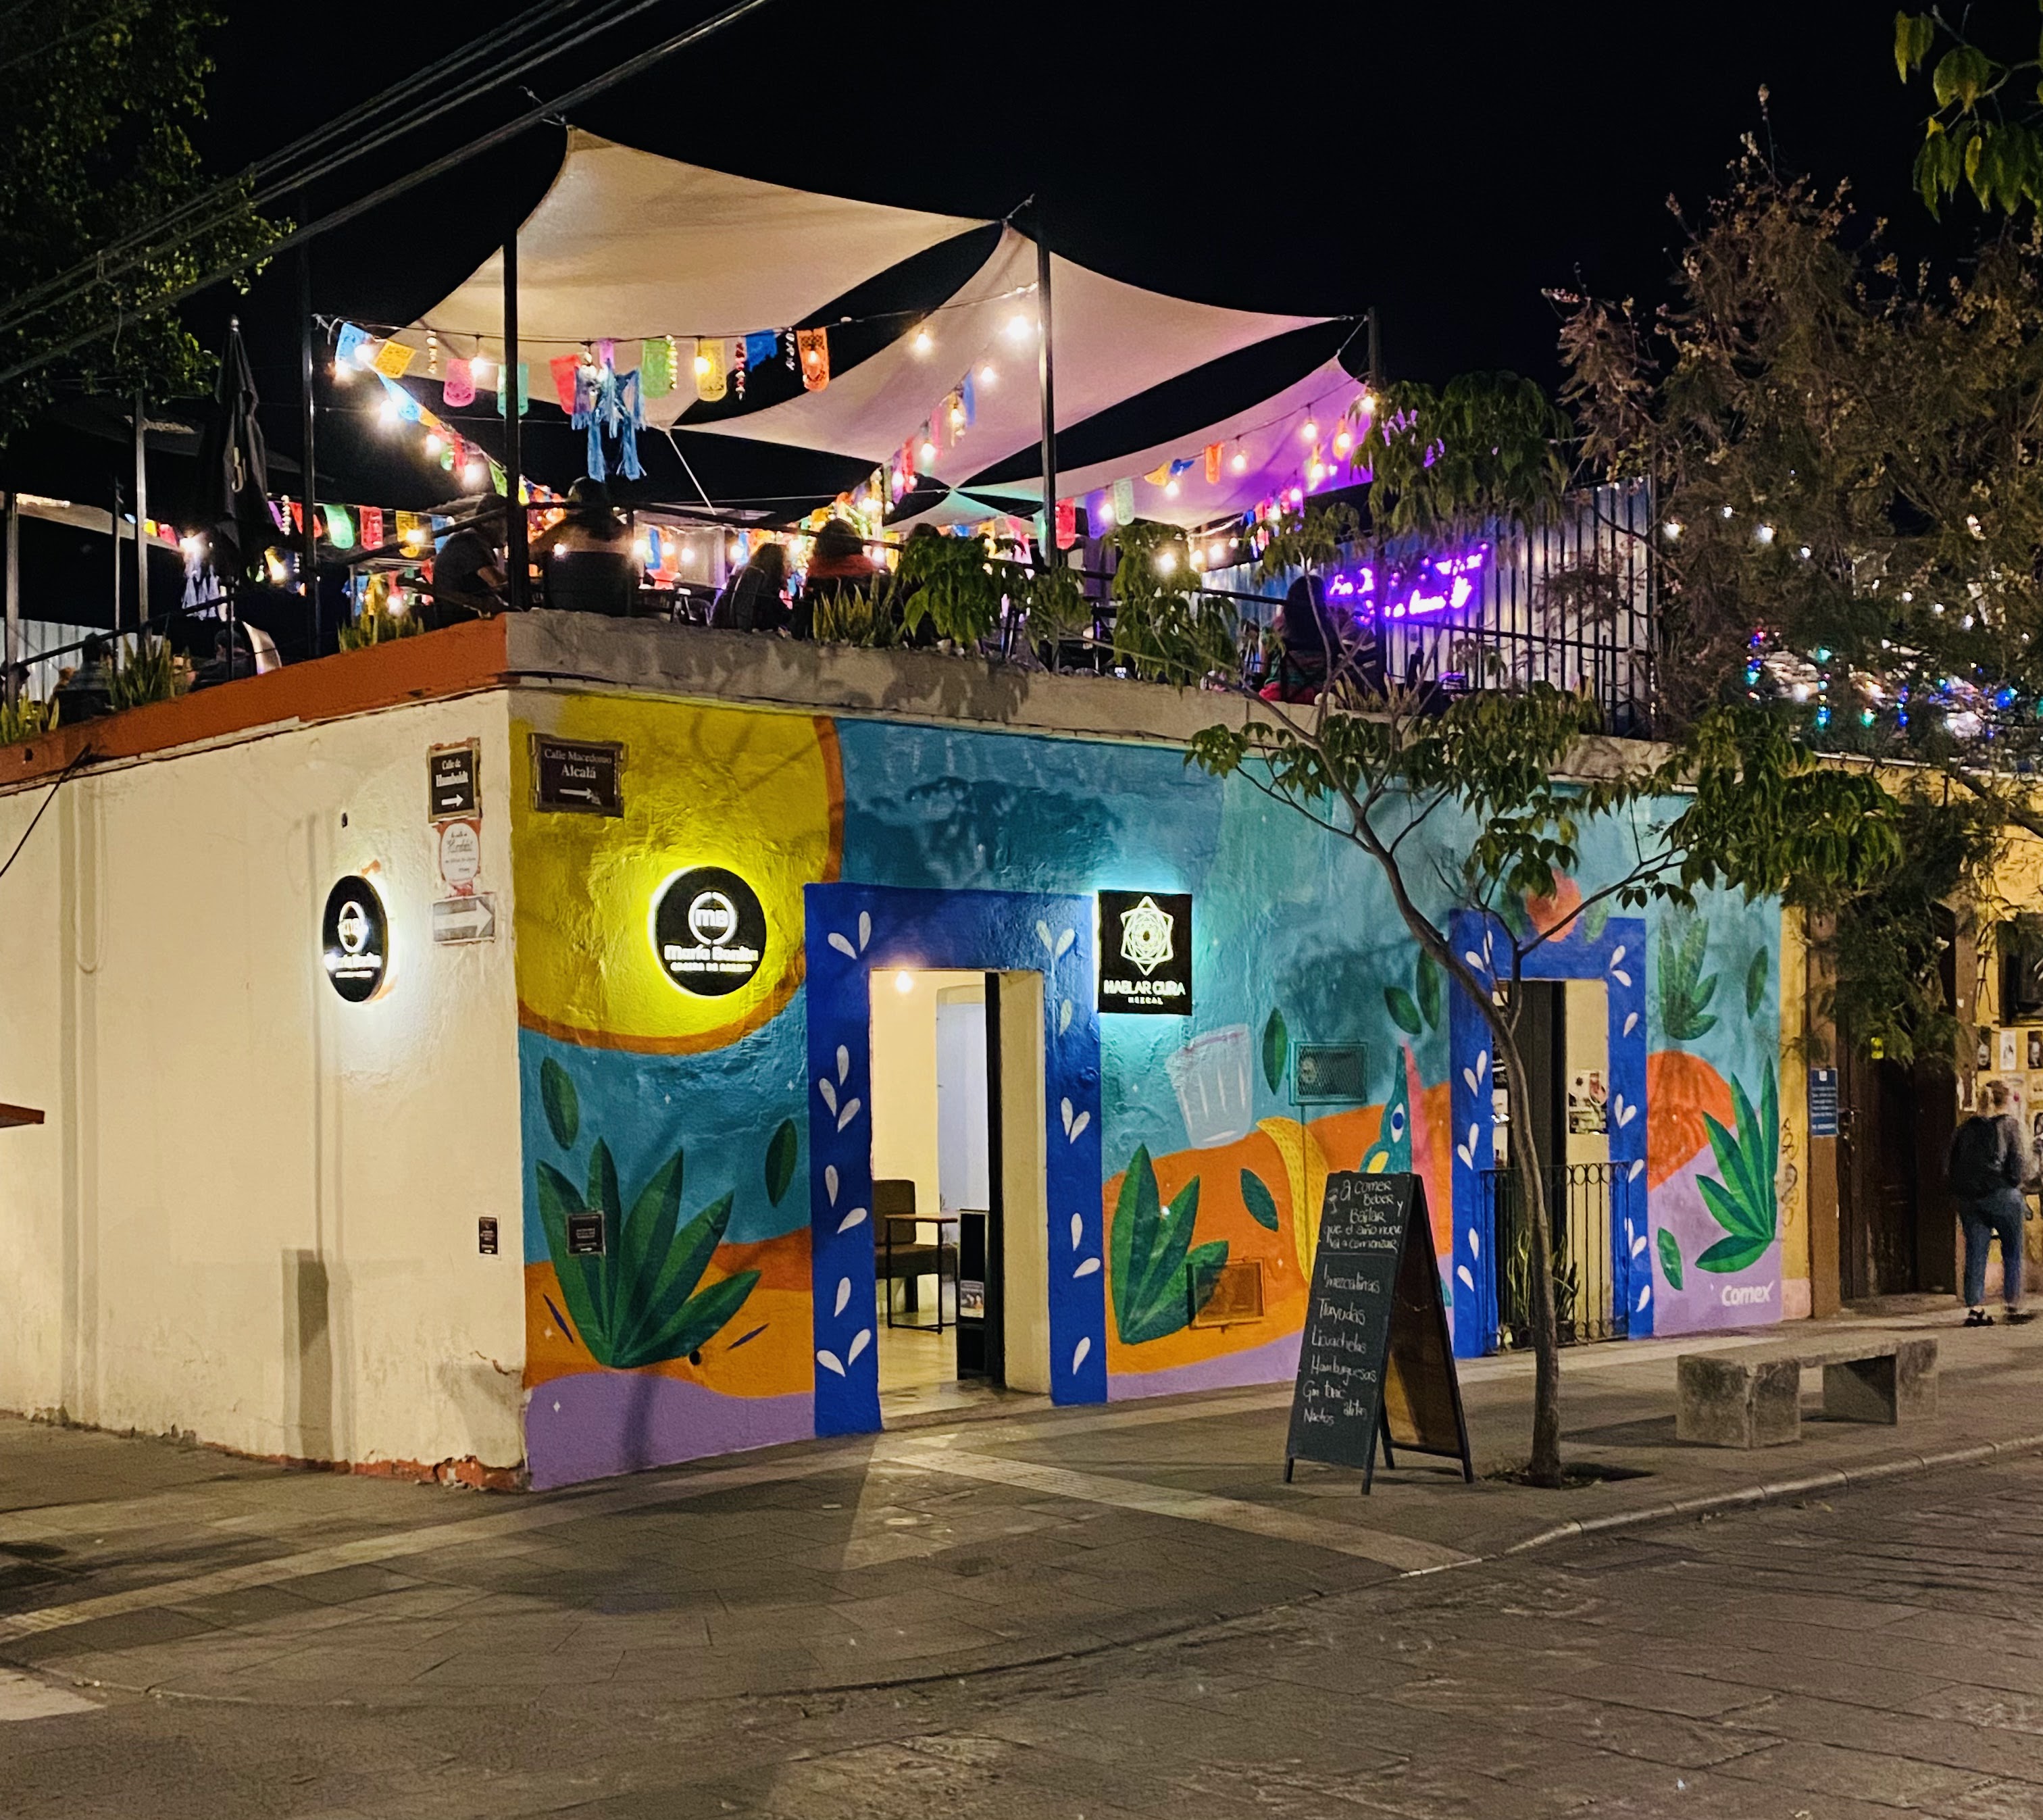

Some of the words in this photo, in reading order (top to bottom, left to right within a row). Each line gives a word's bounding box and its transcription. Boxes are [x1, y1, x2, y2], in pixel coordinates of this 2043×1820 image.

[544, 749, 565, 760] Calle
[561, 763, 597, 779] Alcalá
[1103, 979, 1153, 995] HABLAR
[1152, 980, 1186, 996] CURA
[1356, 1223, 1378, 1235] año
[1721, 1280, 1775, 1307] Comex
